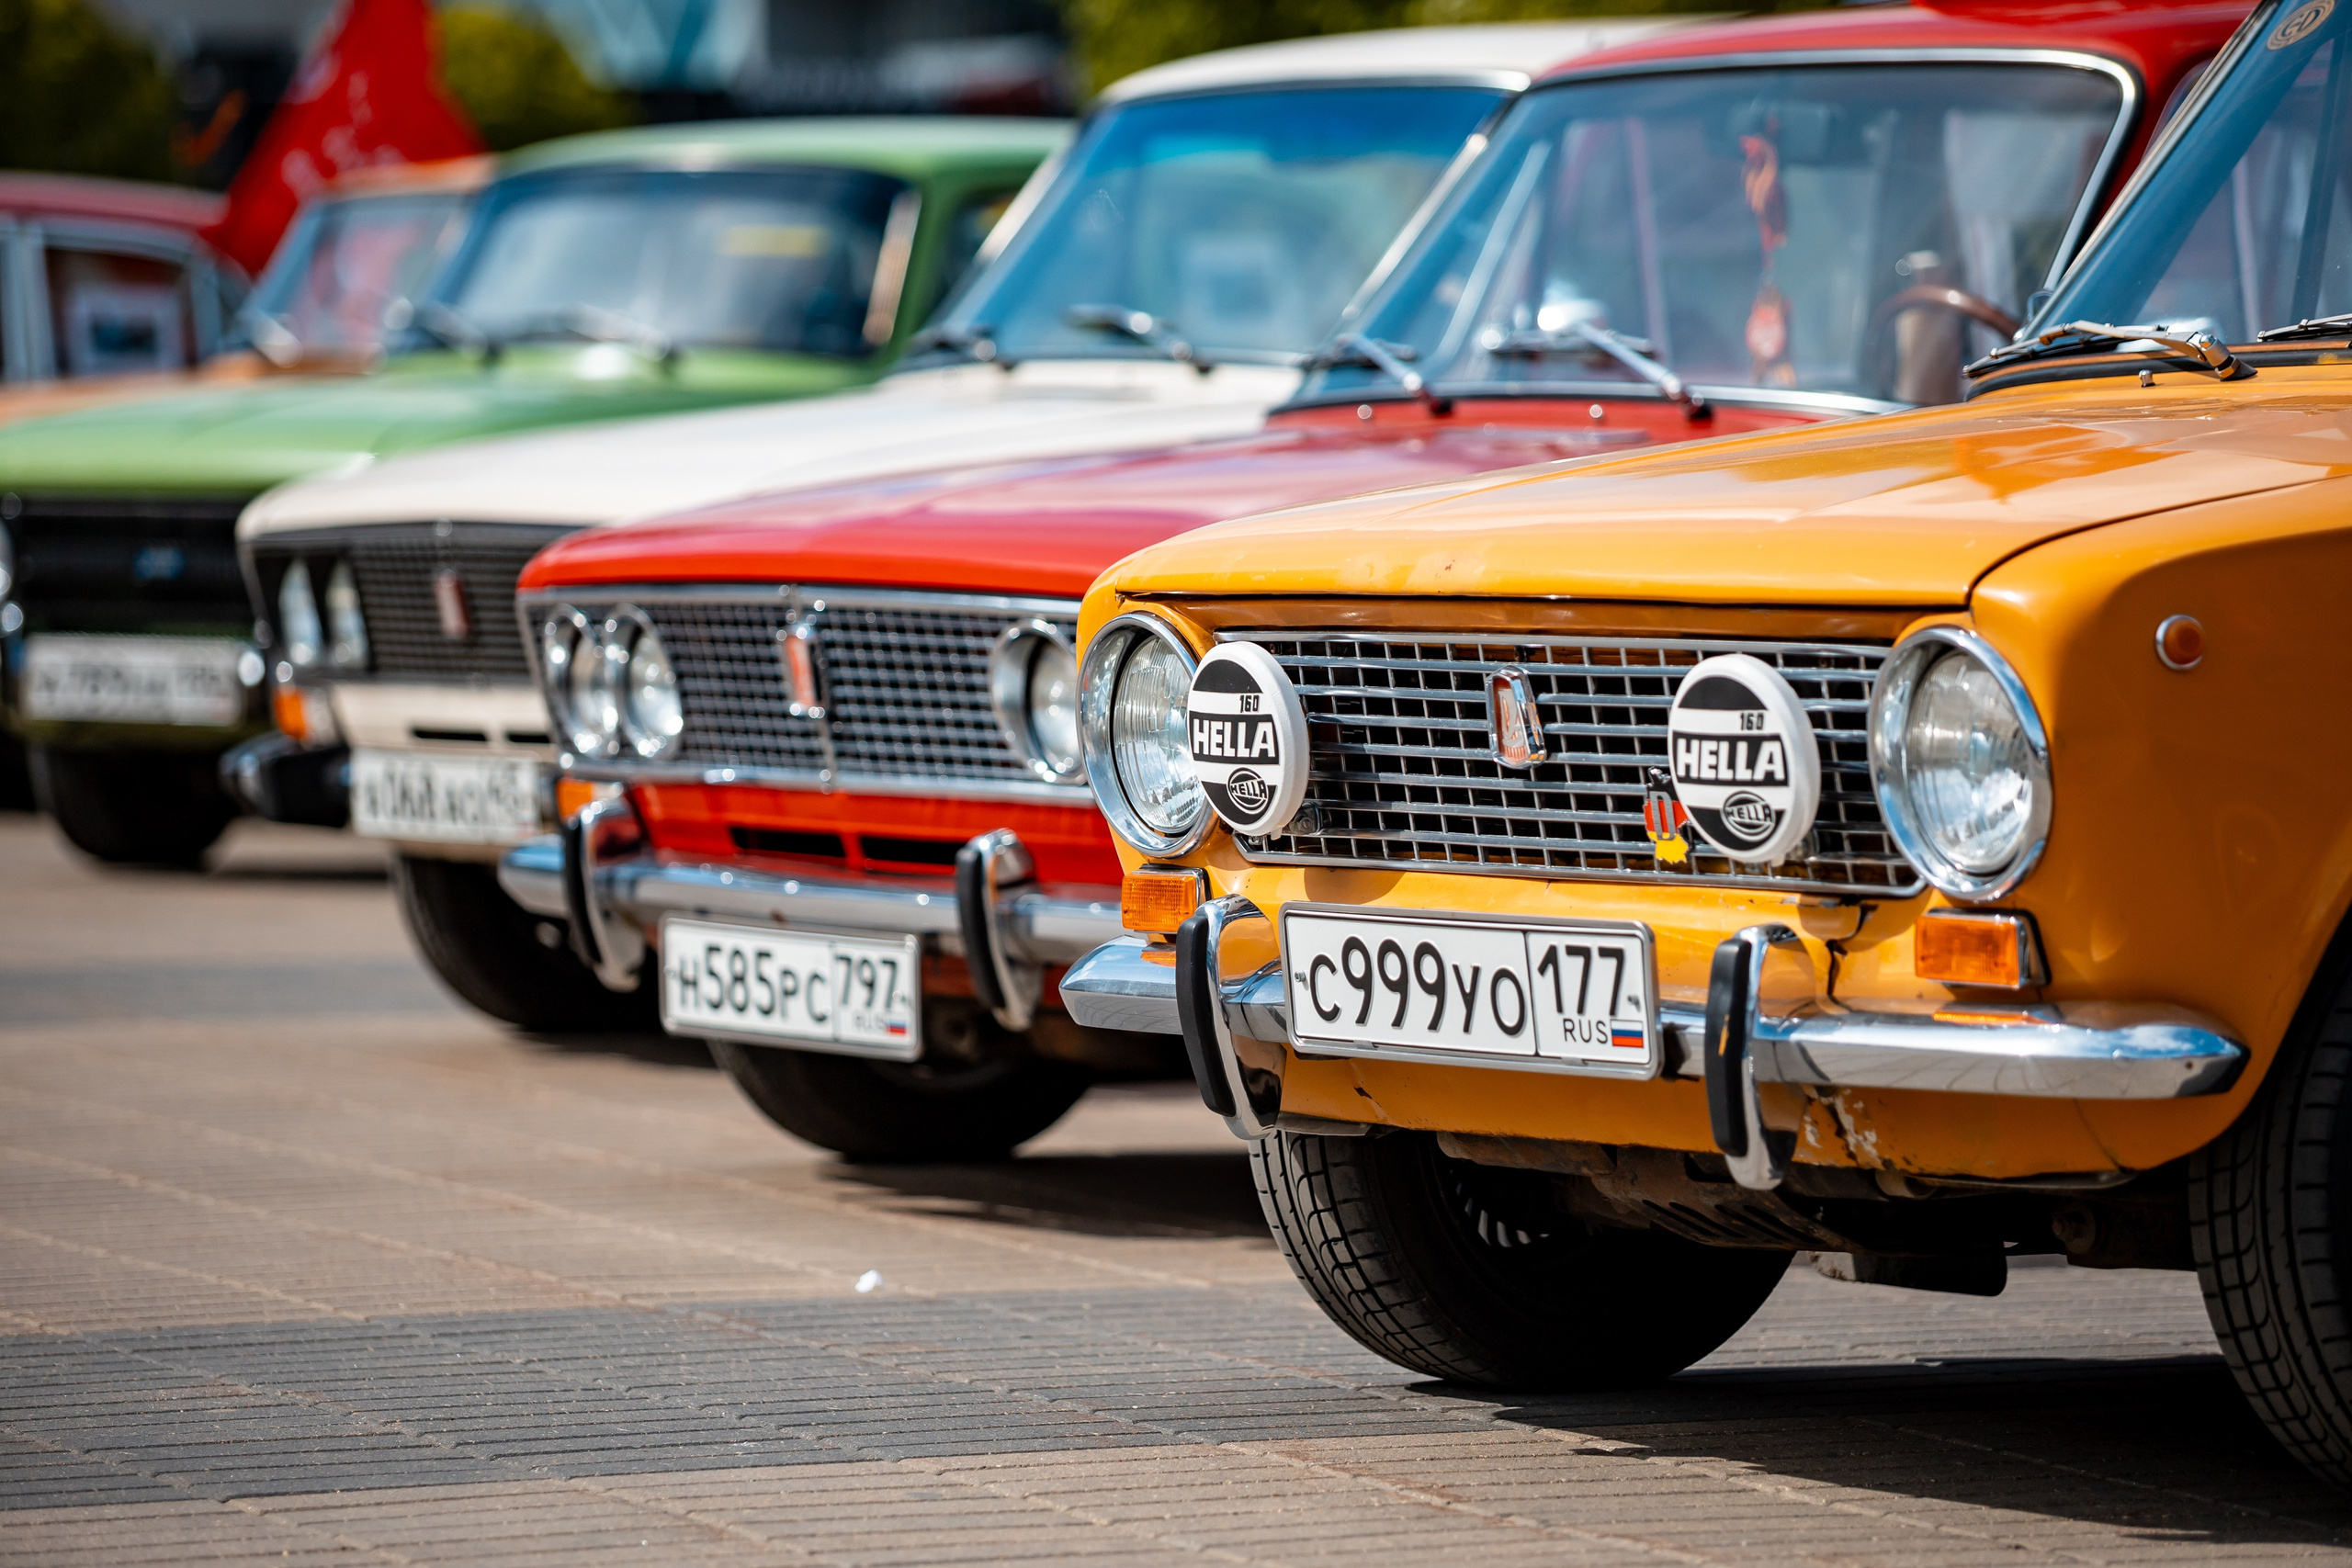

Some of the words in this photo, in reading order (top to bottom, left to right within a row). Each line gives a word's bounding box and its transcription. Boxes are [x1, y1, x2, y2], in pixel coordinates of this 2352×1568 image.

[1239, 694, 1260, 713] 160
[1739, 712, 1764, 730] 160
[1193, 718, 1276, 758] HELLA
[1676, 738, 1785, 781] HELLA
[1230, 778, 1268, 800] HELLA
[1726, 801, 1772, 823] HELLA
[833, 953, 899, 1010] 797
[1537, 944, 1624, 1015] 177
[1564, 1017, 1609, 1044] RUS
